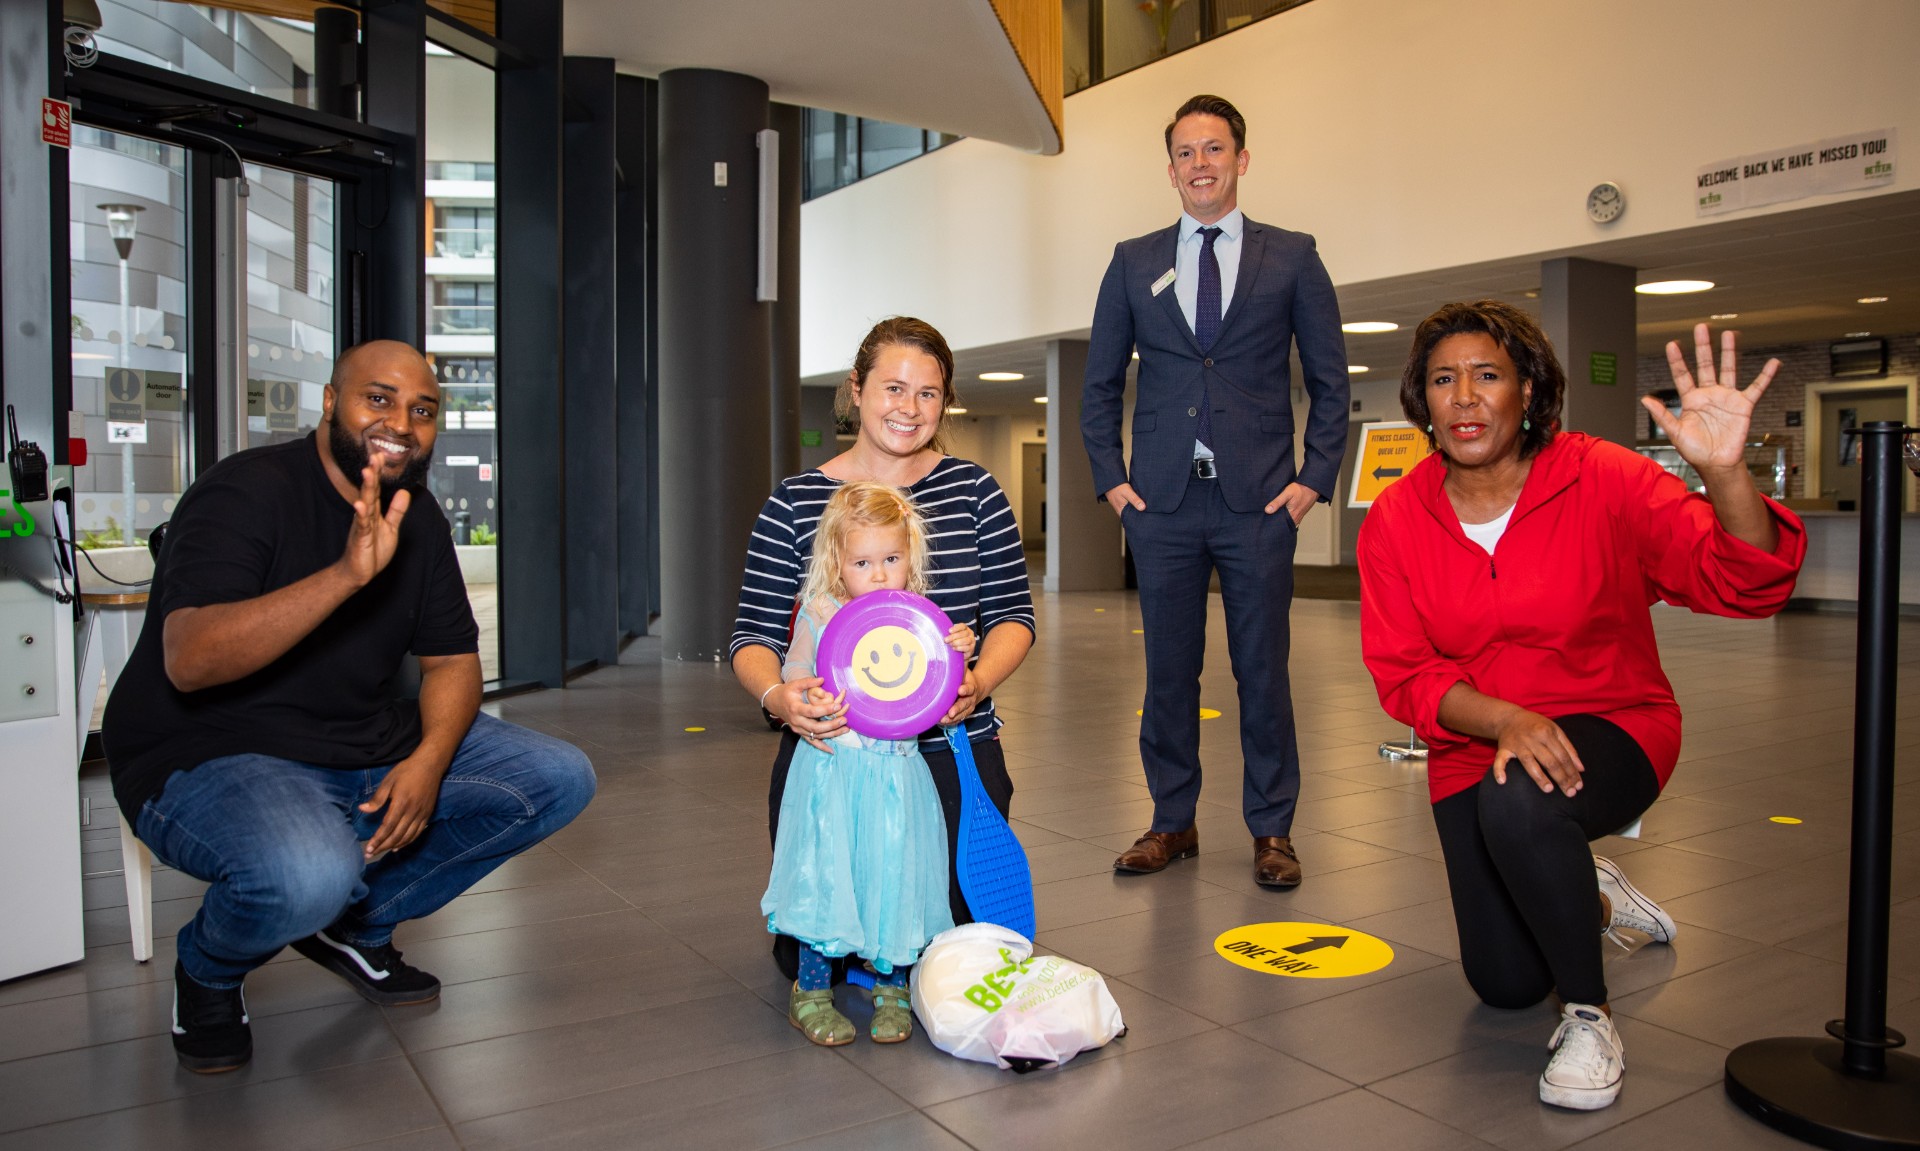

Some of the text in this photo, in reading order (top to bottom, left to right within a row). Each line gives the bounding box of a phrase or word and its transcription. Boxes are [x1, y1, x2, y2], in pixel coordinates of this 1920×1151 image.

[54, 136, 68, 144] point
[1697, 138, 1887, 188] WELCOME BACK WE HAVE MISSED YOU!
[146, 382, 181, 391] Automatic
[156, 391, 172, 399] door
[1372, 434, 1391, 442] FITNESS
[1393, 433, 1415, 441] CLASSES
[1378, 447, 1408, 456] QUEUE LEFT
[1223, 941, 1319, 973] ONE WAY
